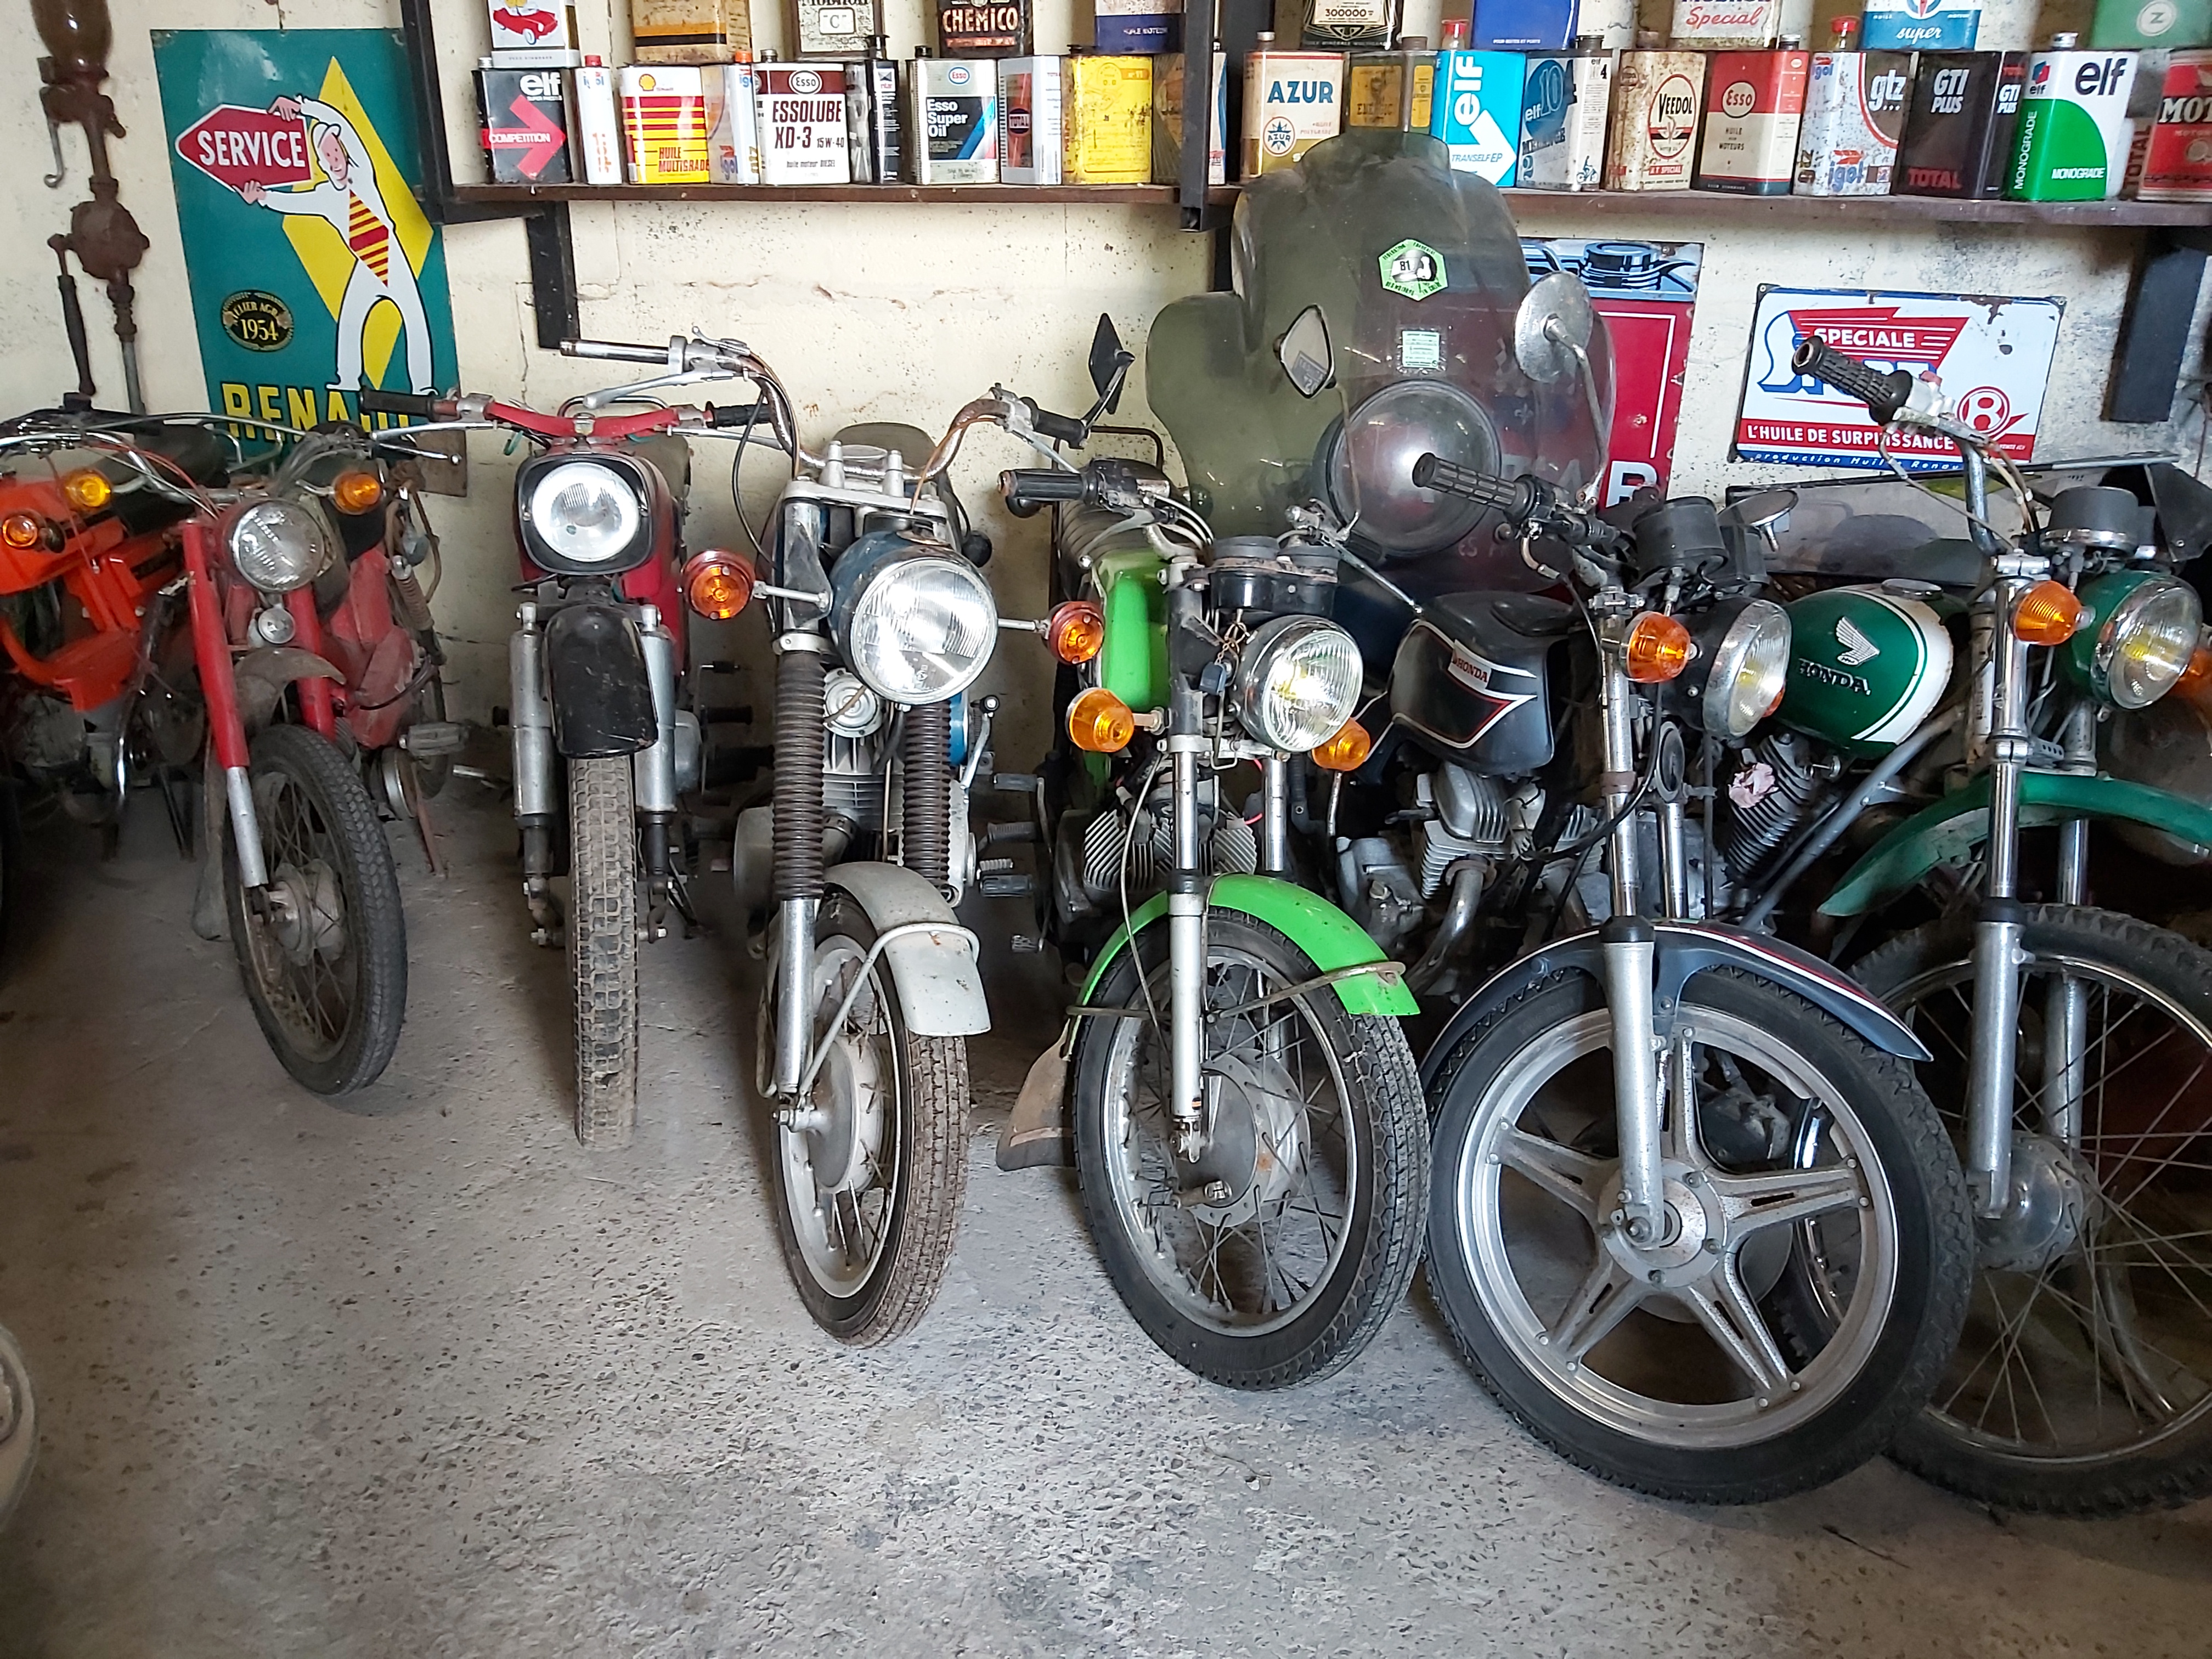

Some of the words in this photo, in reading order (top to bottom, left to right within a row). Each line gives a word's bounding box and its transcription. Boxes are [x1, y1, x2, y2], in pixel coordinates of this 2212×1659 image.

[1325, 9, 1367, 17] 300000
[1686, 6, 1763, 29] Special
[1896, 25, 1942, 45] super
[520, 72, 561, 95] elf
[795, 76, 816, 87] Esso
[1934, 69, 1970, 96] GTI
[2075, 58, 2128, 96] elf
[1267, 81, 1333, 104] AZUR
[1454, 55, 1483, 126] elf
[1725, 89, 1752, 106] Esso
[1999, 84, 2021, 102] GTI
[2030, 83, 2047, 95] elf
[772, 100, 842, 123] ESSOLUBE
[927, 99, 958, 111] Esso
[1525, 103, 1541, 121] elf
[1659, 93, 1692, 122] VEEDOL
[1931, 96, 1964, 114] PLUS
[1997, 101, 2017, 114] PLUS
[927, 113, 968, 127] Super
[1009, 115, 1029, 127] TOTAL
[488, 132, 550, 144] COMPETITION
[928, 125, 947, 137] Oil
[1267, 134, 1290, 143] AZUR
[197, 129, 306, 168] SERVICE
[659, 146, 681, 159] HUILE
[1491, 153, 1503, 162] EP
[2014, 111, 2037, 190] MONOGRADE
[1828, 160, 1864, 193] igol
[1909, 168, 1961, 189] TOTAL
[2051, 167, 2105, 180] MONOGRADE
[240, 319, 279, 341] 1954
[1814, 328, 1916, 348] SPECIALE
[1747, 425, 1803, 442] L'HUILE
[1807, 428, 1827, 443] DE
[1754, 453, 1841, 465] production
[1457, 658, 1488, 683] HONDA
[1798, 658, 1872, 696] HONDA
